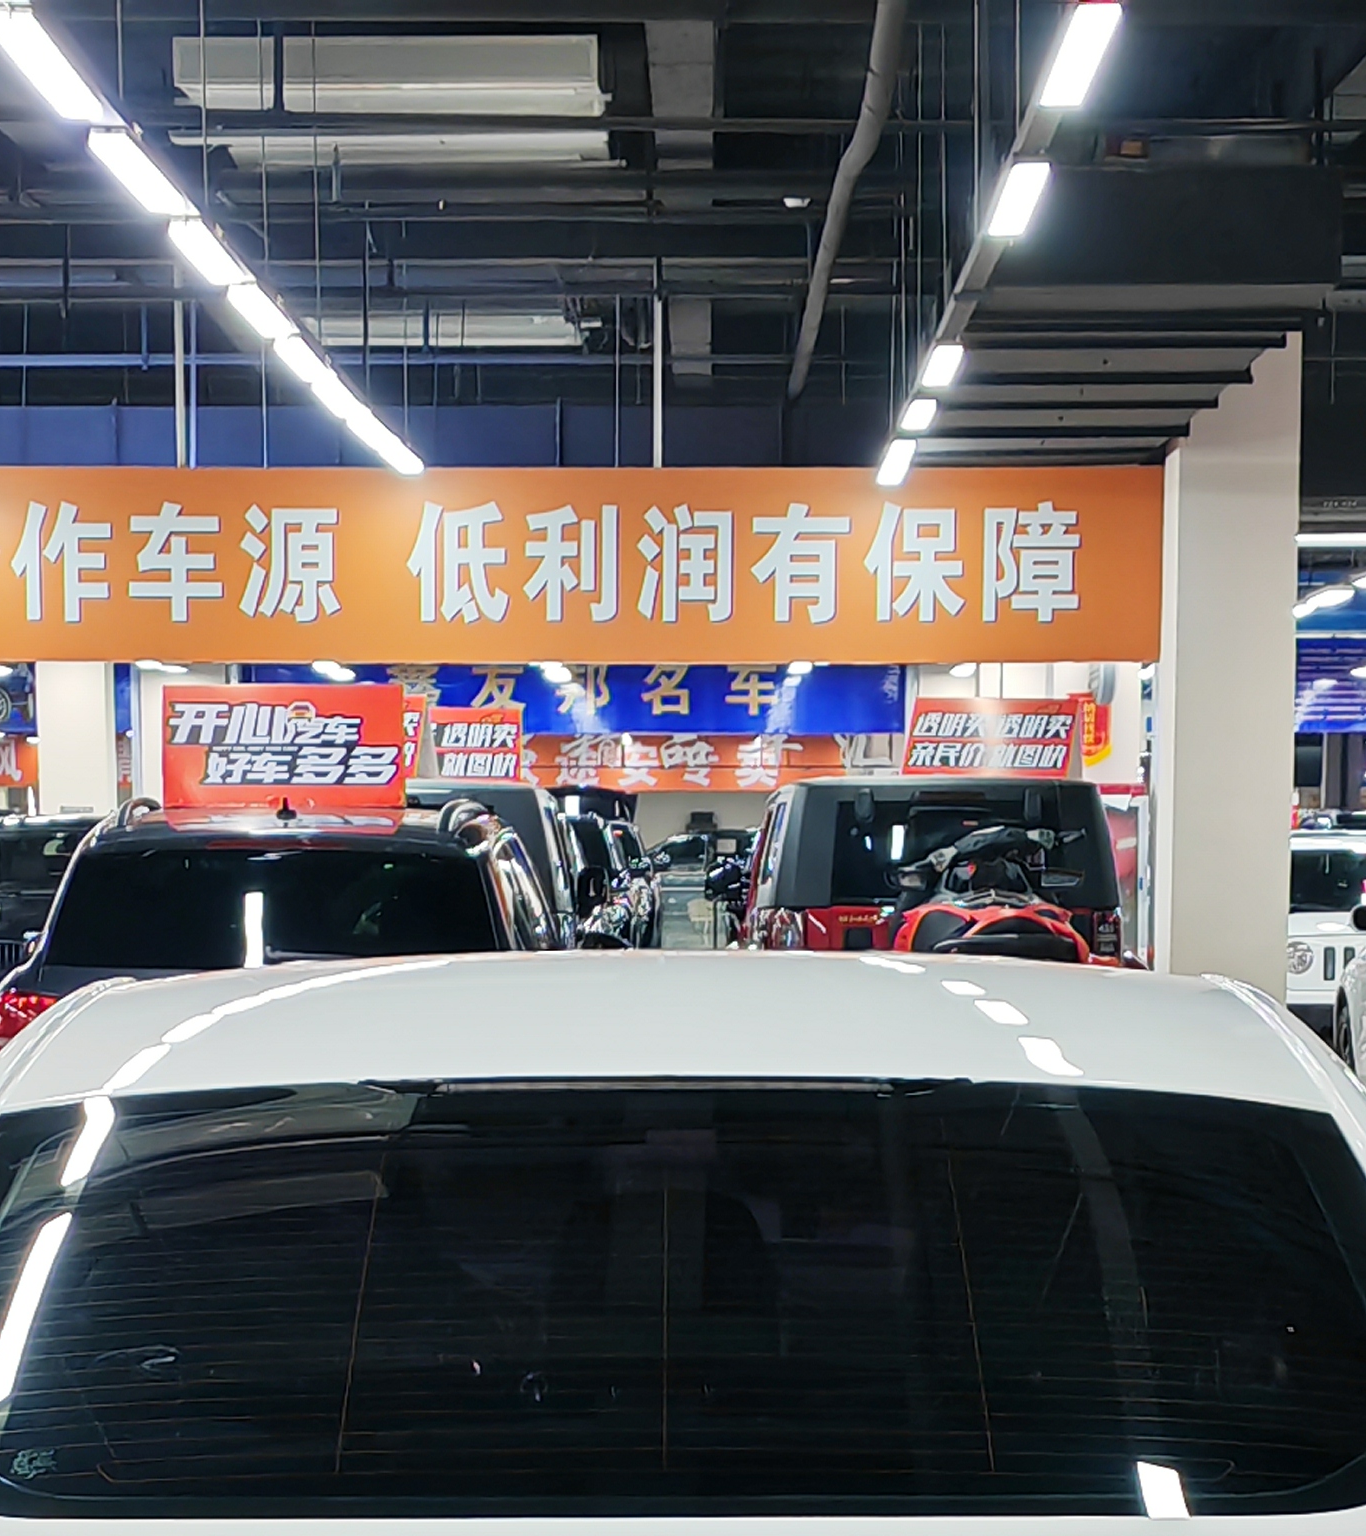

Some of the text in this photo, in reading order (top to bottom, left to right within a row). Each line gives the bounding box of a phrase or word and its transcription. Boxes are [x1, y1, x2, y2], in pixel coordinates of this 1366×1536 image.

[409, 501, 1082, 624] 低利润有保障
[169, 702, 362, 745] 开心汽车
[206, 746, 400, 785] 好车多多
